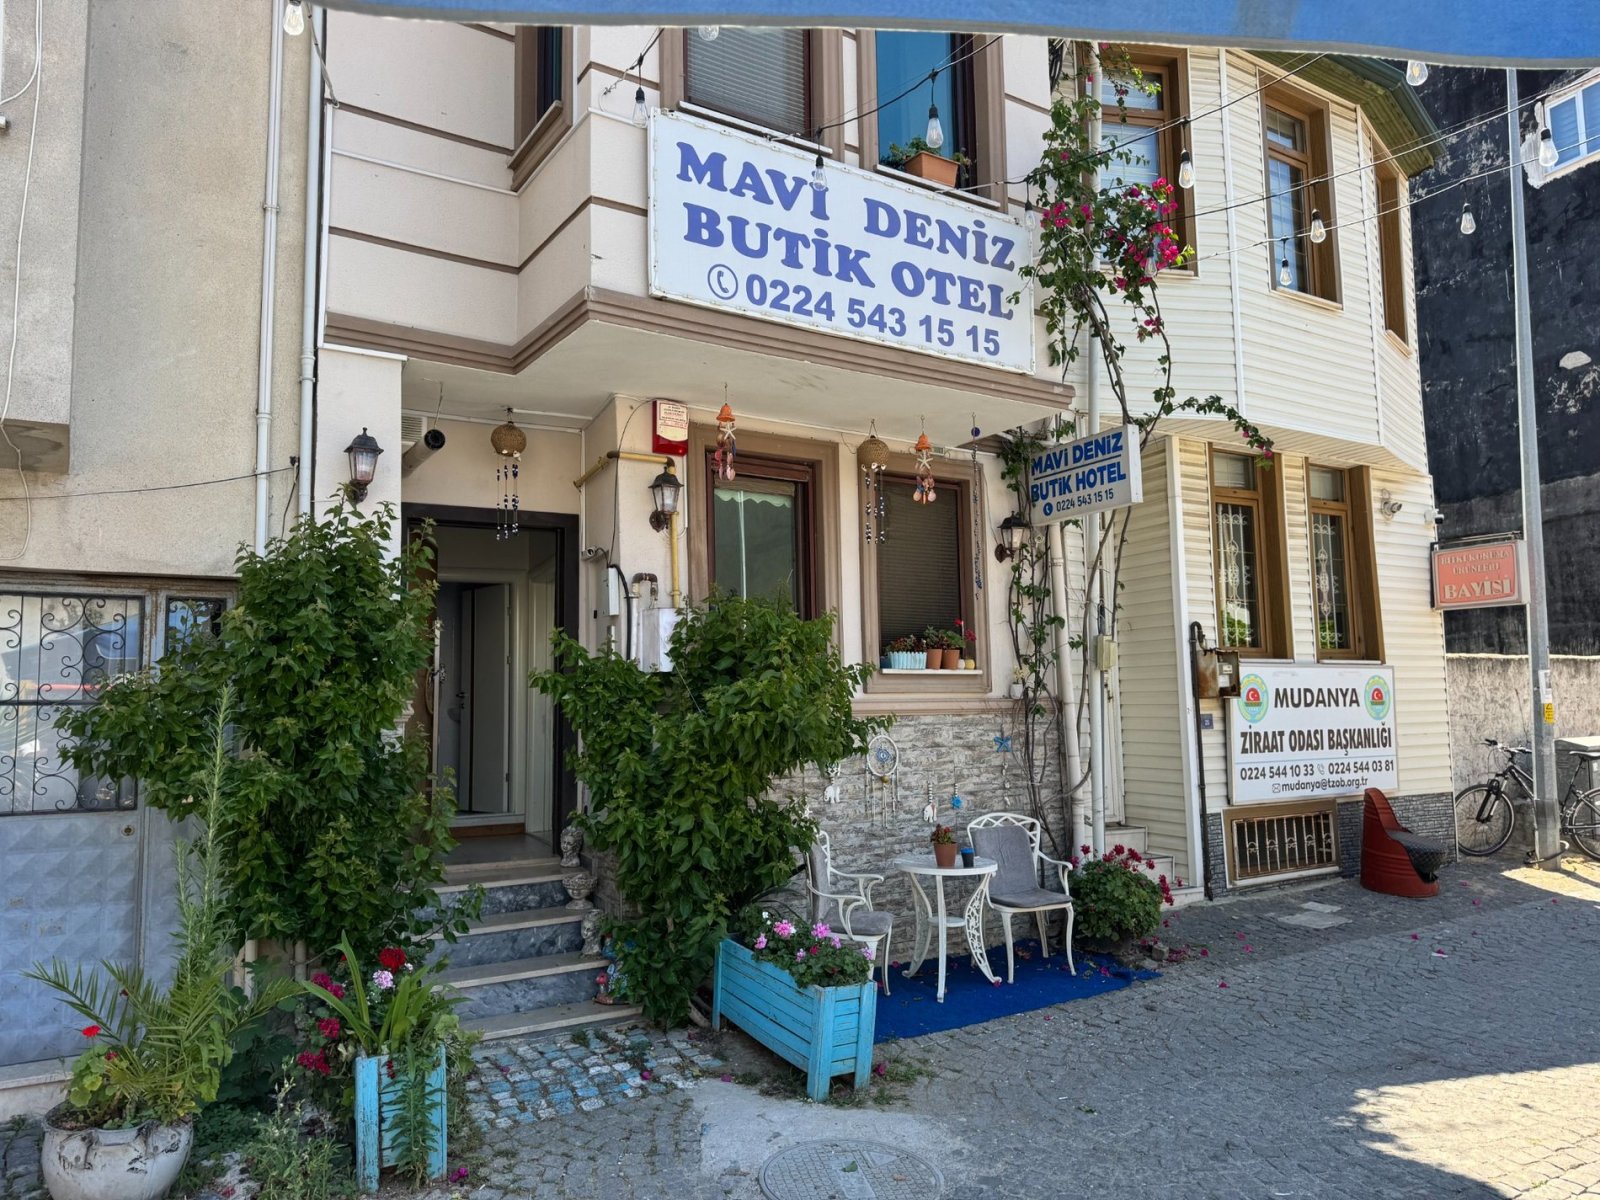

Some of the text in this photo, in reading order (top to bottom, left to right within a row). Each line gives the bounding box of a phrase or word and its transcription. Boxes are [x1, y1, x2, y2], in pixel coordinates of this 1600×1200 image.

[676, 141, 1016, 272] MAVİ DENİZ
[683, 201, 1014, 321] BUTİK OTEL
[745, 273, 1001, 357] 0224 543 15 15
[1075, 461, 1127, 492] HOTEL
[1056, 487, 1114, 512] 0224 543 15 15
[1444, 575, 1511, 600] BAYİSİ
[1274, 687, 1361, 709] MUDANYA
[1240, 721, 1392, 757] ZİRAAT ODASI BAŞKANLIĞI
[1240, 763, 1315, 781] 0224 544 10 33
[1328, 759, 1394, 776] 0224 544 03 81
[1281, 776, 1368, 794] mudanya@tzob.org.tr
